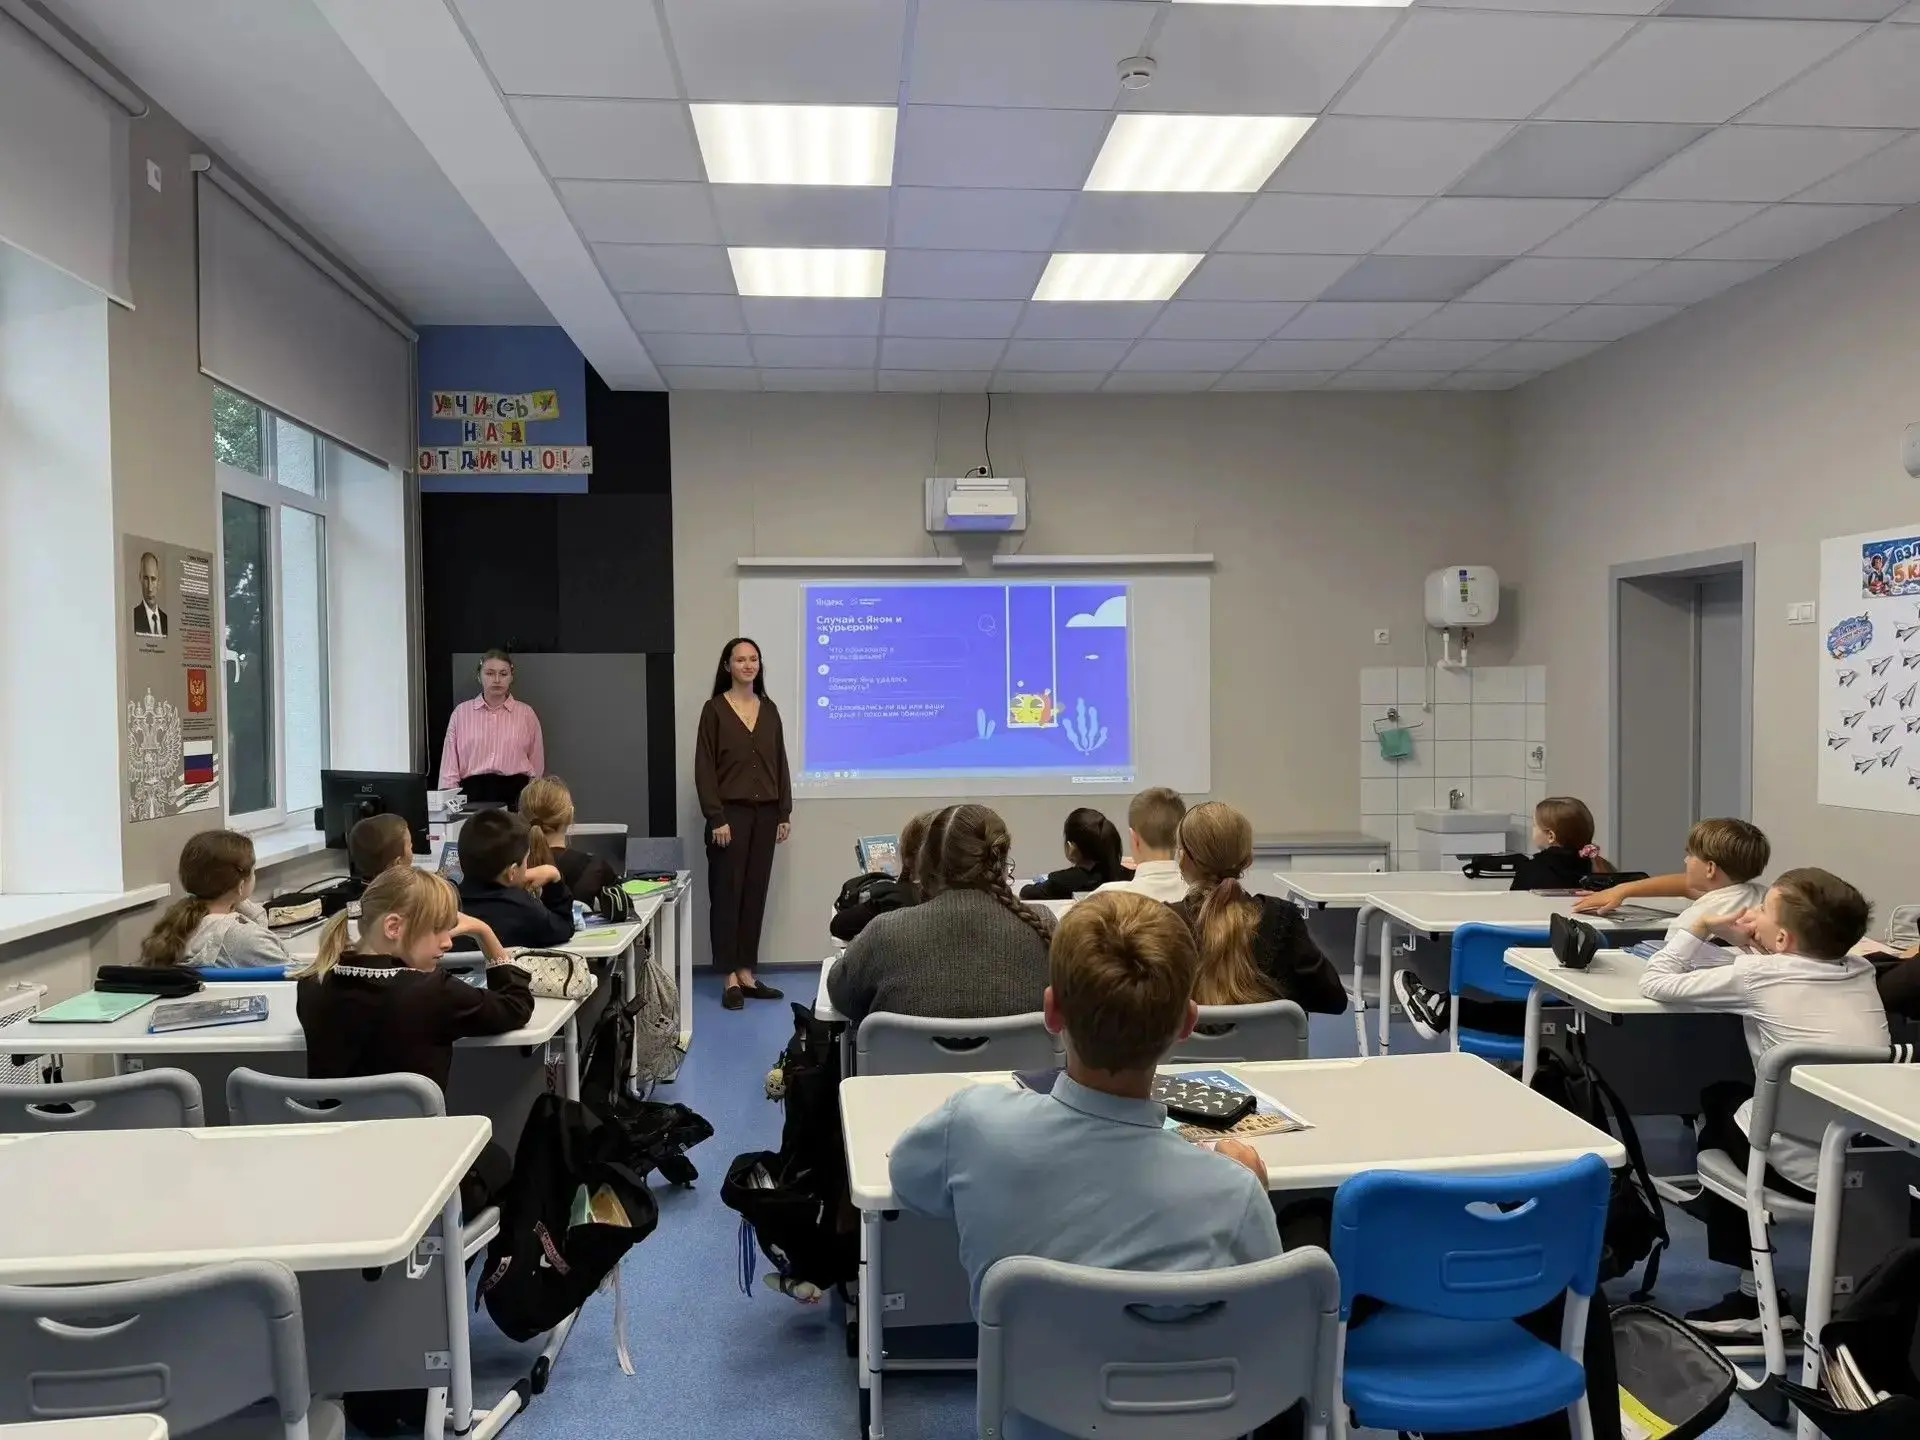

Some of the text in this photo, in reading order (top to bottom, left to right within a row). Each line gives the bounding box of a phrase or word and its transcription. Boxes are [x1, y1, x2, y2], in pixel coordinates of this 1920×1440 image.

[434, 394, 529, 418] УЧИСЬ
[464, 420, 498, 442] НА
[419, 450, 571, 471] ОТЛИЧНО!
[816, 615, 855, 626] Случай
[866, 615, 893, 624] Яном
[895, 616, 902, 624] и
[816, 624, 879, 633] «курьером»
